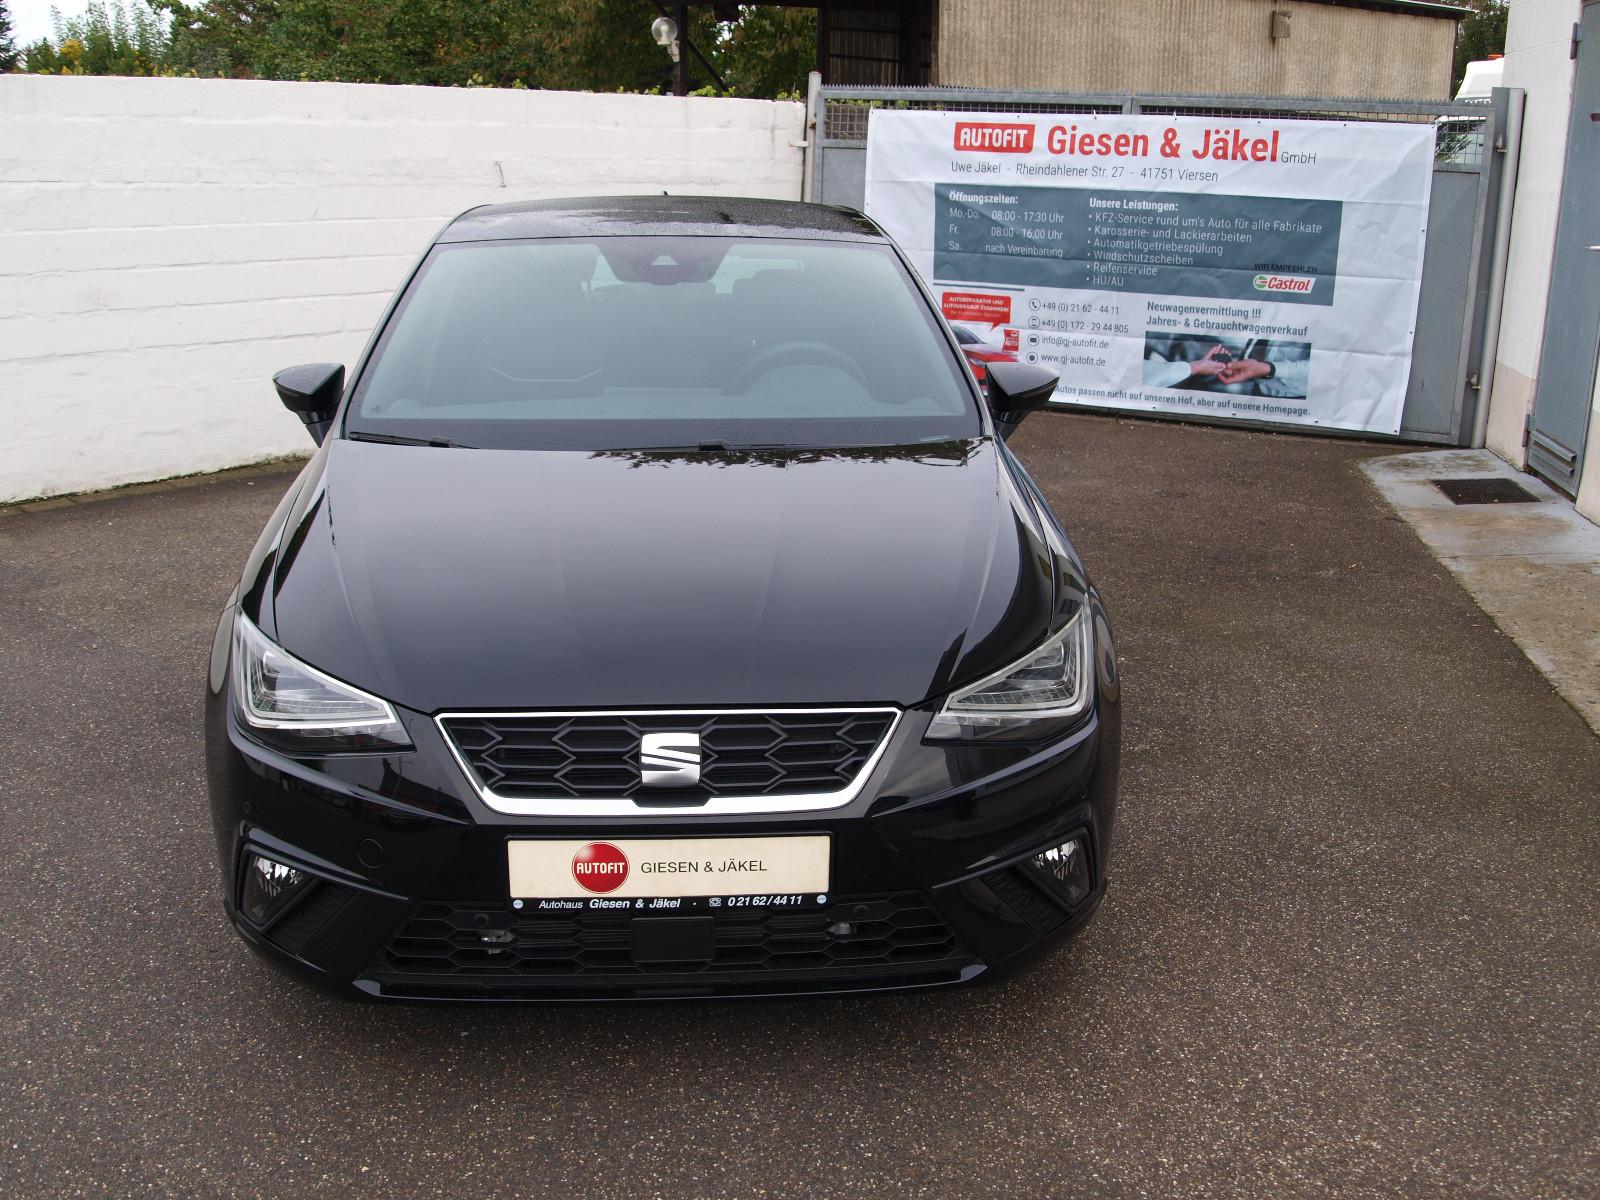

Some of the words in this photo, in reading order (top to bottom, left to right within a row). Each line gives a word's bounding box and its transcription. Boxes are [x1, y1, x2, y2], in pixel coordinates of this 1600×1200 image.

[960, 127, 1028, 148] AUTOFIT
[1047, 125, 1149, 157] Giesen
[1160, 127, 1181, 158] &
[1192, 129, 1279, 162] Jäkel
[1281, 152, 1317, 165] GmbH
[951, 161, 972, 173] Uwe
[974, 161, 1001, 173] Jäkel
[1016, 164, 1088, 177] Rheindahlener
[1091, 165, 1109, 177] Str.
[1111, 166, 1124, 178] 27
[1140, 168, 1173, 180] 41751
[1178, 169, 1218, 182] Viersen
[949, 190, 1019, 204] Öffnungszeiten:
[1089, 198, 1121, 209] Unsere
[1123, 200, 1179, 212] Leistungen:
[991, 210, 1016, 221] 08:00
[1049, 212, 1065, 223] Uhr
[1095, 212, 1154, 225] KFZ-Service
[1156, 217, 1179, 226] rund
[1182, 217, 1205, 228] um's
[1207, 217, 1231, 229] Auto
[1234, 218, 1249, 229] für
[1252, 220, 1271, 231] alle
[1273, 221, 1323, 234] Fabrikate
[991, 226, 1014, 237] 08:00
[1047, 229, 1063, 240] Uhr
[1094, 225, 1150, 237] Karosserie-
[1152, 229, 1171, 238] und
[1174, 229, 1252, 243] Lackierarbeiten
[985, 243, 1006, 254] nach
[1007, 244, 1063, 257] Vereinbarung
[1093, 238, 1224, 256] Automatikgetriebespülung
[1093, 250, 1194, 265] Windschutzscheiben
[1093, 262, 1158, 276] Reifenservice
[1092, 275, 1124, 287] HU/AU
[1267, 276, 1311, 292] Castrol
[1042, 302, 1056, 311] +49
[1058, 303, 1069, 313] (0)
[1147, 302, 1249, 319] Neuwagenvermittlung
[1042, 320, 1056, 328] +49
[1057, 320, 1068, 330] (0)
[1071, 321, 1085, 330] 172
[1146, 316, 1182, 327] Jahres-
[1184, 318, 1191, 327] &
[1193, 319, 1309, 337] Gebrauchtwagenverkauf
[1041, 336, 1110, 349] info@gj-autofit.de
[1041, 354, 1106, 367] www.gj-autofit.de
[1078, 388, 1105, 398] passen
[1107, 390, 1127, 400] nicht
[1129, 391, 1142, 401] auf
[1144, 394, 1176, 404] unseren
[1177, 396, 1195, 407] Hof,
[1196, 398, 1215, 407] aber
[1216, 400, 1230, 409] auf
[1232, 402, 1260, 411] unsere
[1262, 404, 1311, 416] Homepage.
[576, 862, 626, 875] AUTOFIT
[640, 861, 699, 874] GIESEN
[703, 861, 714, 873] &
[718, 857, 768, 873] JÄKEL
[538, 900, 583, 910] Autohaus
[589, 898, 630, 909] Giesen
[635, 899, 644, 909] &
[649, 898, 681, 909] Jäkel
